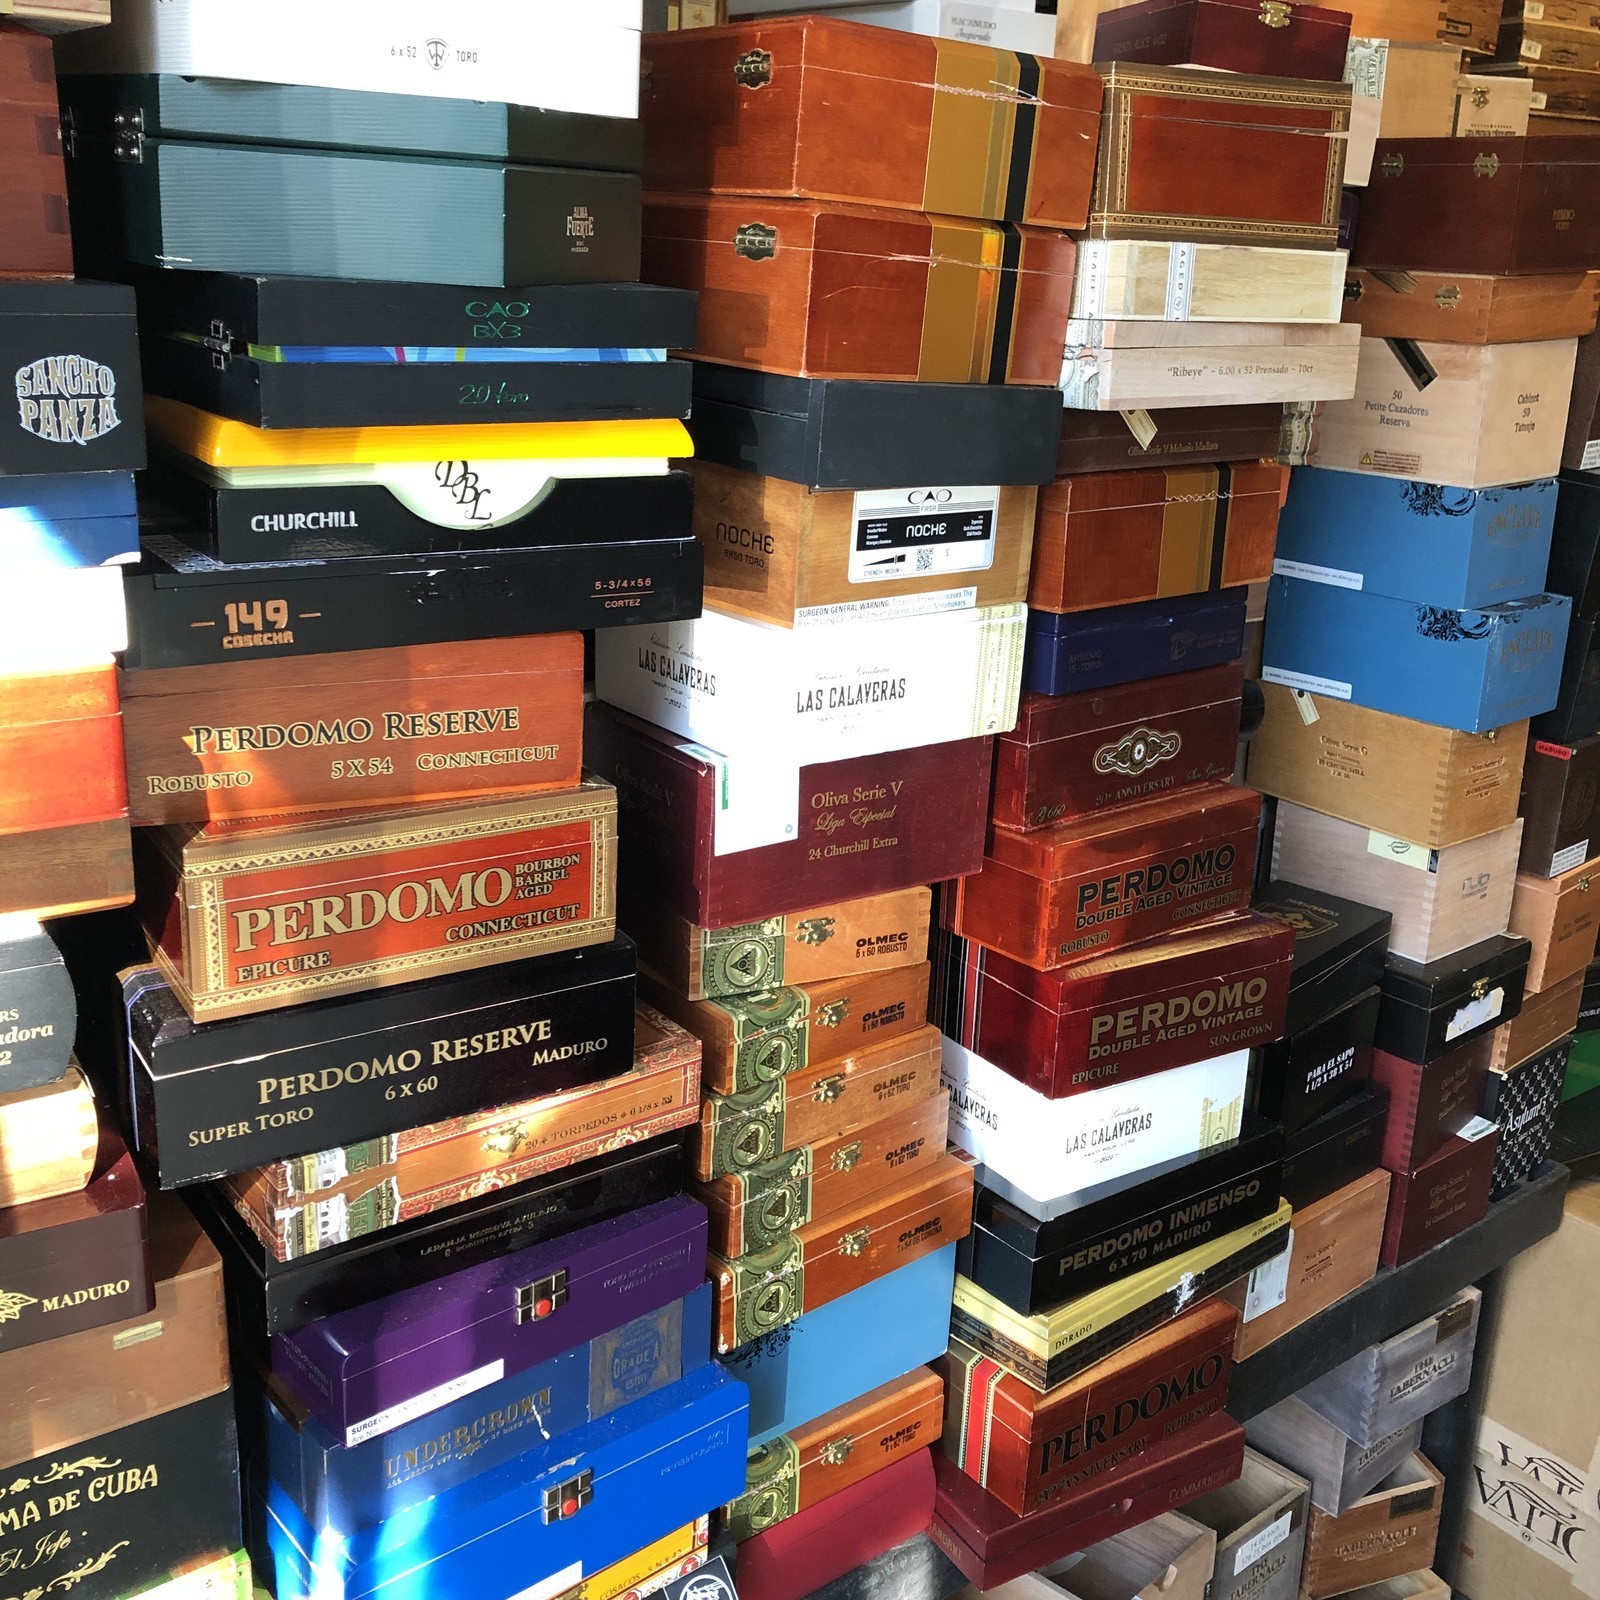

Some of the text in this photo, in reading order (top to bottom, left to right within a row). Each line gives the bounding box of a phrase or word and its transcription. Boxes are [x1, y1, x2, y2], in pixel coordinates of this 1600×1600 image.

[951, 16, 997, 30] MACANUDO
[407, 46, 417, 58] 52
[456, 50, 478, 63] TORO
[573, 206, 588, 217] ALMA
[566, 216, 594, 238] FUERTE
[1177, 249, 1187, 292] AGED
[465, 301, 531, 318] CAO
[473, 321, 522, 339] BX3
[15, 354, 117, 398] SANCHO
[1218, 365, 1236, 377] 6.00
[1244, 366, 1254, 376] 52
[1255, 364, 1289, 376] Prensado
[1364, 401, 1430, 417] Petite Cazadores
[1392, 390, 1403, 401] 50
[18, 397, 121, 446] PANZA
[1379, 414, 1412, 428] Reserva
[1522, 407, 1531, 418] 50
[907, 488, 953, 504] CAO
[250, 510, 359, 533] CHURCHILL
[905, 523, 947, 538] NOCHE
[715, 521, 775, 555] NOCHE
[223, 599, 289, 633] 149
[604, 598, 641, 609] CORTEZ
[798, 608, 830, 619] SURGEON
[830, 603, 858, 616] GENERAL
[860, 600, 890, 613] WARNING
[222, 631, 295, 650] COSECHA
[638, 647, 717, 697] LAS CALAVERAS
[797, 677, 907, 713] LAS CALAVERAS
[190, 706, 521, 758] PERDOMO RESERVE
[331, 744, 560, 779] 5 X 54 CONNECTICUT
[1537, 743, 1568, 758] MADURO
[146, 770, 254, 796] ROBUSTO
[811, 780, 904, 810] Oliva Serie V
[1114, 776, 1176, 800] ANNIVERSARY
[814, 804, 898, 836] Liga Especial
[808, 836, 899, 861] 24 Churchill Extra
[514, 853, 582, 876] BOURBON
[514, 868, 571, 888] BARREL
[514, 882, 554, 901] AGED
[1075, 843, 1237, 915] PERDOMO
[231, 866, 514, 955] PERDOMO
[1075, 873, 1232, 930] DOUBLE AGED VINTAGE
[1172, 890, 1242, 921] CONNECTICUT
[443, 903, 582, 944] CONNECTICUT
[856, 932, 908, 948] OLMEC
[877, 941, 908, 954] ROBUSTO
[1060, 930, 1109, 956] ROBUSTO
[235, 949, 332, 985] EPICURE
[862, 1001, 906, 1023] OLMEC
[880, 1010, 905, 1026] ROBUSTO
[1090, 977, 1268, 1045] PERDOMO
[1088, 1005, 1264, 1061] DOUBLE AGED VINTAGE
[1208, 1021, 1273, 1049] SUN GROWN
[258, 1018, 553, 1106] PERDOMO RESERVE
[531, 1036, 609, 1067] MADURO
[1306, 1046, 1355, 1082] PARA EL SAPO
[873, 1071, 917, 1094] OLMEC
[1071, 1062, 1120, 1085] EPICURE
[384, 1074, 439, 1101] 6 X 60
[187, 1104, 314, 1148] SUPER TORO
[525, 1139, 539, 1151] 20
[551, 1113, 618, 1142] TORPEDOS
[638, 1102, 652, 1114] 1/8
[1066, 1112, 1153, 1155] LAS CALAVERAS
[885, 1137, 925, 1162] OLMEC
[898, 1217, 941, 1243] OLMEC
[1059, 1179, 1261, 1277] PERDOMO INMENSO
[420, 1235, 467, 1257] LARANJA
[1108, 1220, 1212, 1273] 6 X 70 MADURO
[42, 1279, 131, 1314] MADURO
[1055, 1323, 1093, 1351] DORADO
[613, 1346, 660, 1380] GRADE A
[1389, 1353, 1456, 1398] TABERNACLE
[1039, 1353, 1225, 1477] PERDOMO
[384, 1385, 553, 1479] UNDERCROWN
[879, 1420, 922, 1447] OLMEC
[1062, 1399, 1218, 1490] ANNIVERSARY ROBUSTO
[48, 1464, 159, 1518] DE CUBA
[599, 1572, 642, 1599] COSACOS
